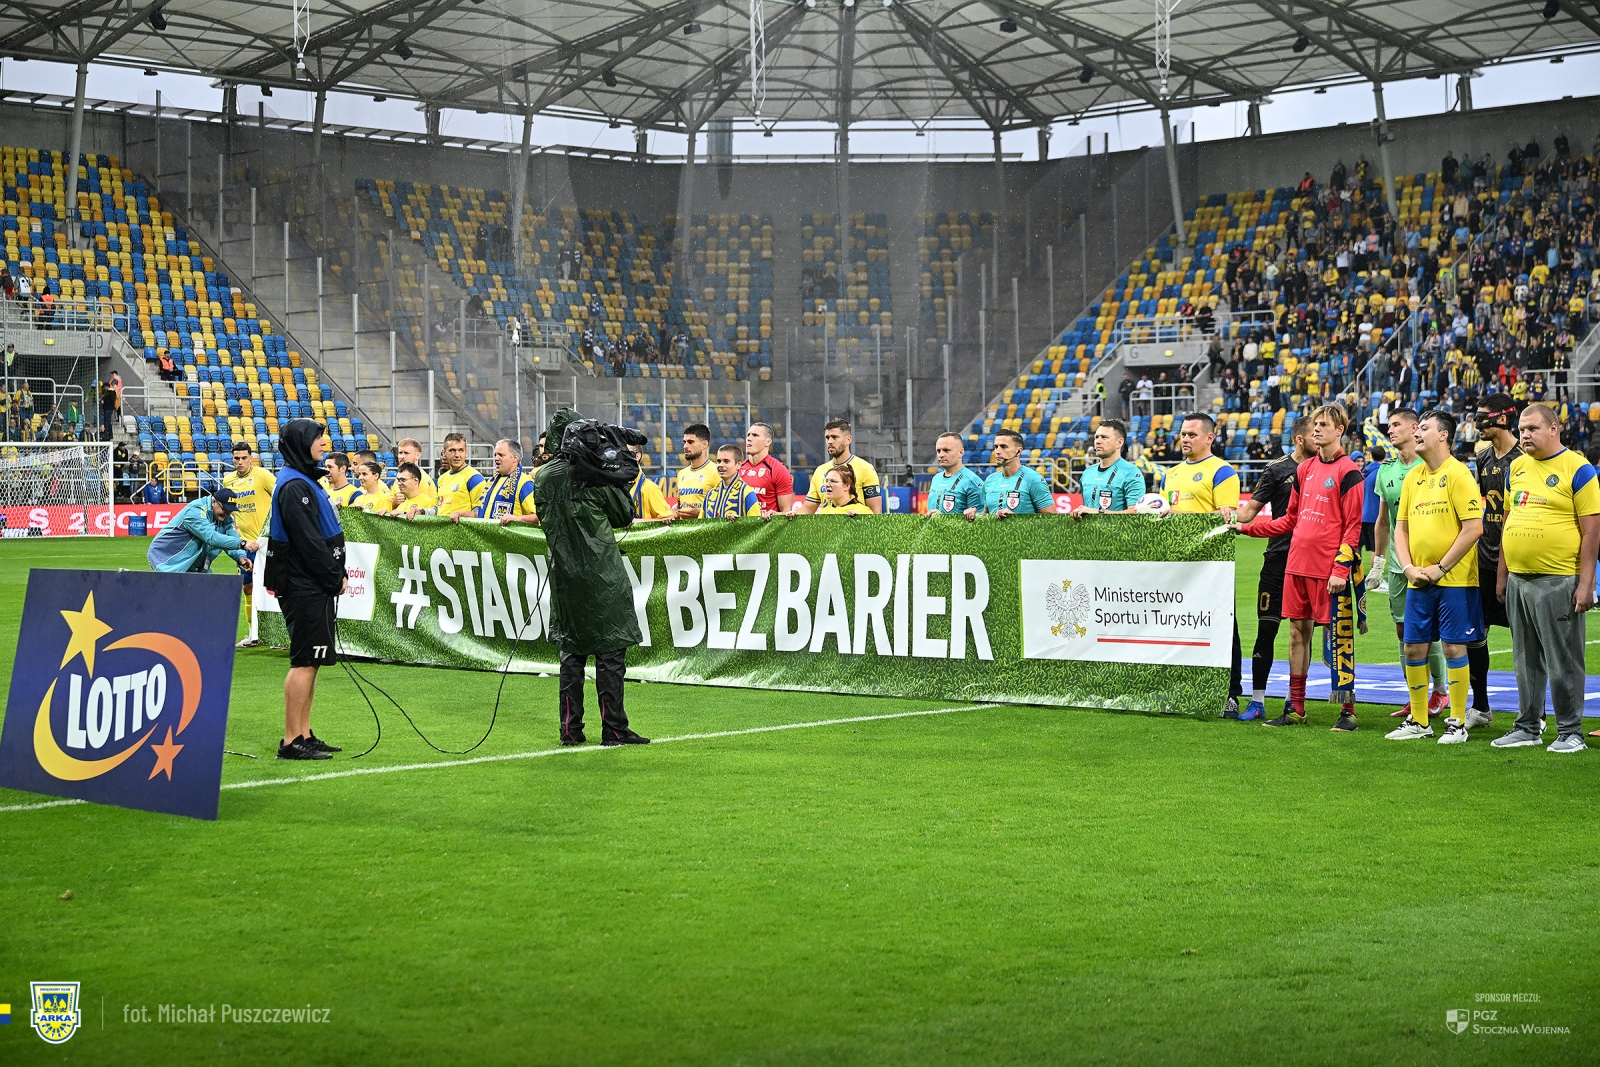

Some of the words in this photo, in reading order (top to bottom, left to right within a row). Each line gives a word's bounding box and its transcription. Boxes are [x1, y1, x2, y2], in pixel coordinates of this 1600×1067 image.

[1485, 513, 1504, 523] RLEN
[391, 544, 655, 647] #STADIY
[774, 553, 994, 660] BARIER
[1094, 586, 1184, 604] Ministerstwo
[1094, 608, 1140, 626] Sportu
[1143, 609, 1149, 625] i
[1151, 609, 1212, 630] Turystyki
[312, 645, 328, 659] 77
[66, 663, 167, 749] LOTTO
